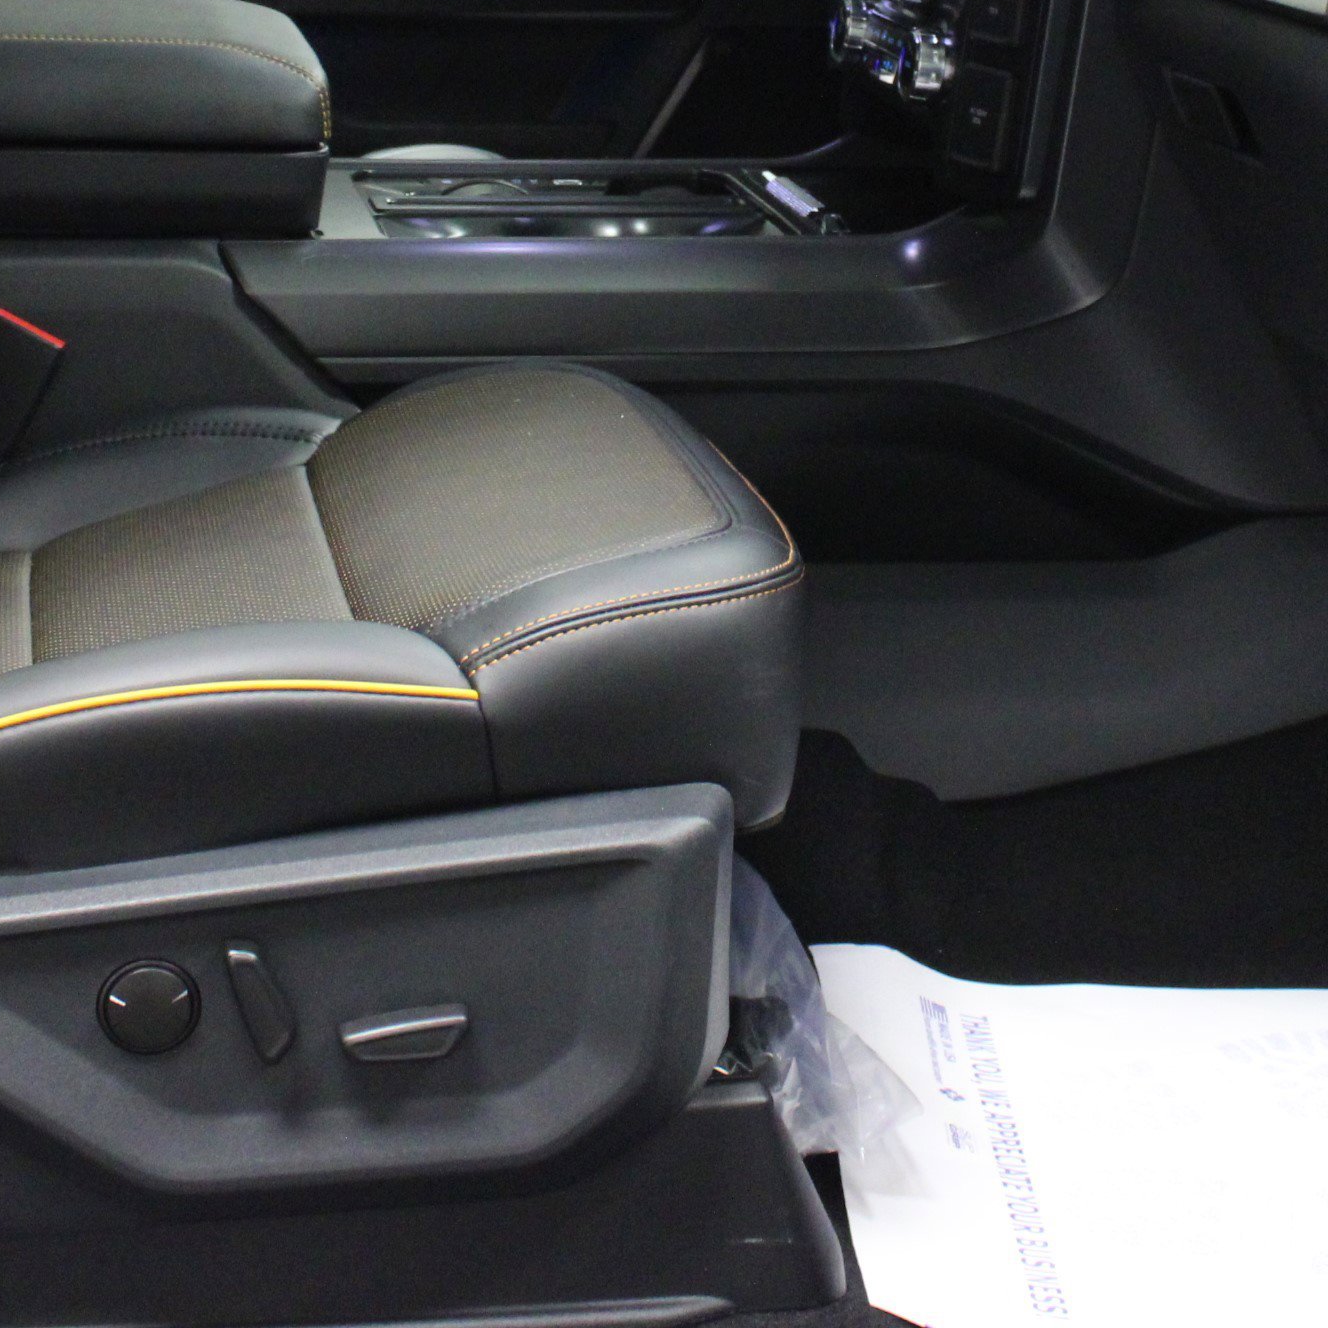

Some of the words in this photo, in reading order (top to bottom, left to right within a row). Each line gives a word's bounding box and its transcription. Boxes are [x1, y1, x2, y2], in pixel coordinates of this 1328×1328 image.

[960, 1013, 996, 1054] THANK
[983, 1109, 1033, 1191] APPRECIATE
[1005, 1195, 1044, 1234] YOUR
